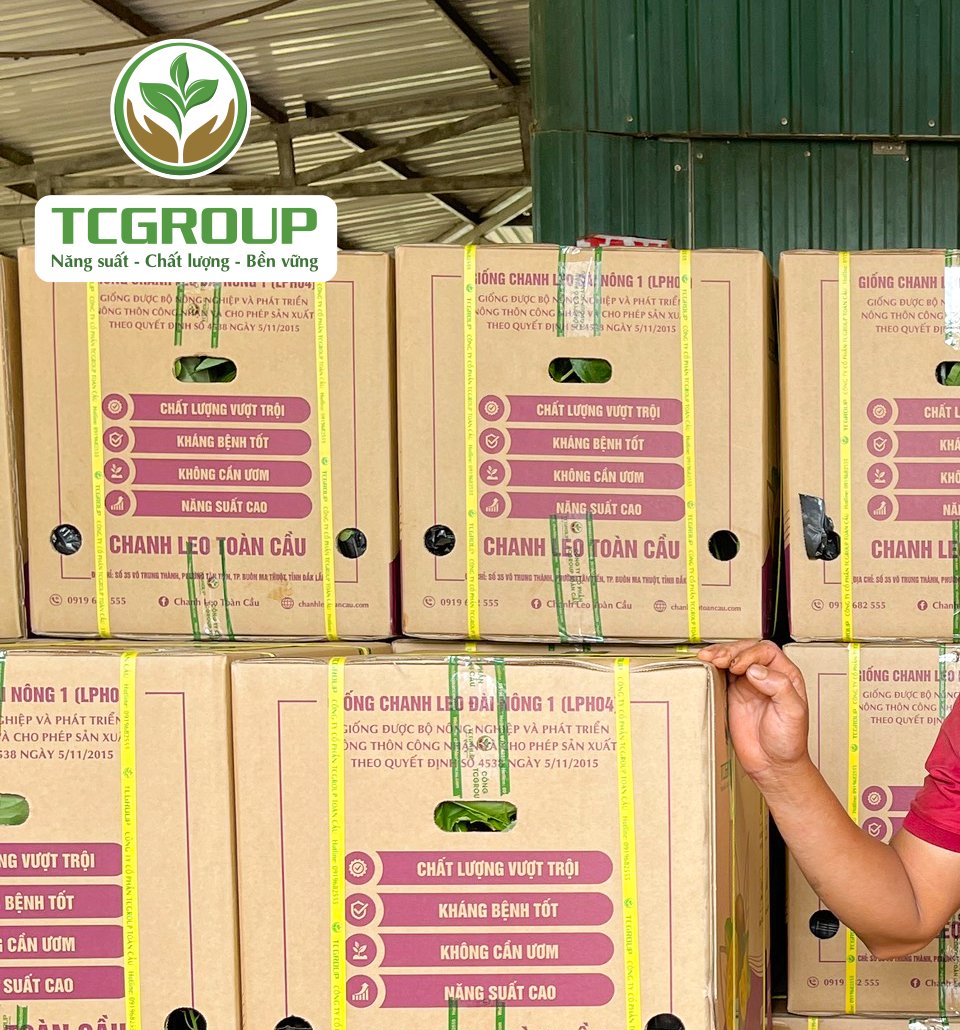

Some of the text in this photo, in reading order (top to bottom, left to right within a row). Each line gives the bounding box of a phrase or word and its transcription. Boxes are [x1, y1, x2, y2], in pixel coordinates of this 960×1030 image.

[858, 276, 937, 289] GIỐNG CHANH
[487, 321, 676, 333] THEO QUYẾT NGÀY 5/11/2015
[160, 399, 285, 419] CHẤT LƯỢNG VƯỢT TRỘI
[924, 403, 952, 418] CHẤT
[553, 435, 645, 452] KHÁNG BỆNH TỐT
[554, 467, 644, 483] KHÔNG CẦN ƯƠM
[182, 497, 267, 513] NĂNG SUẤT CAO
[109, 535, 171, 555] CHANH
[270, 531, 306, 557] CẦU
[20, 750, 114, 760] NGÀY 5/11/2015
[351, 755, 599, 769] THEO QUYẾT NGÀY 5/11/2015
[22, 850, 95, 871] VƯỢT TRỘI
[417, 857, 579, 879] CHẤT LƯỢNG VƯỢT TRỘI
[5, 890, 74, 913] BỆNH TỐT
[439, 898, 559, 921] KHÁNG BỆNH TỐT
[440, 940, 559, 960] KHÔNG CẦN ƯƠM
[3, 973, 74, 993] SUẤT CAO
[444, 980, 556, 1001] NĂNG SUẤT CAO
